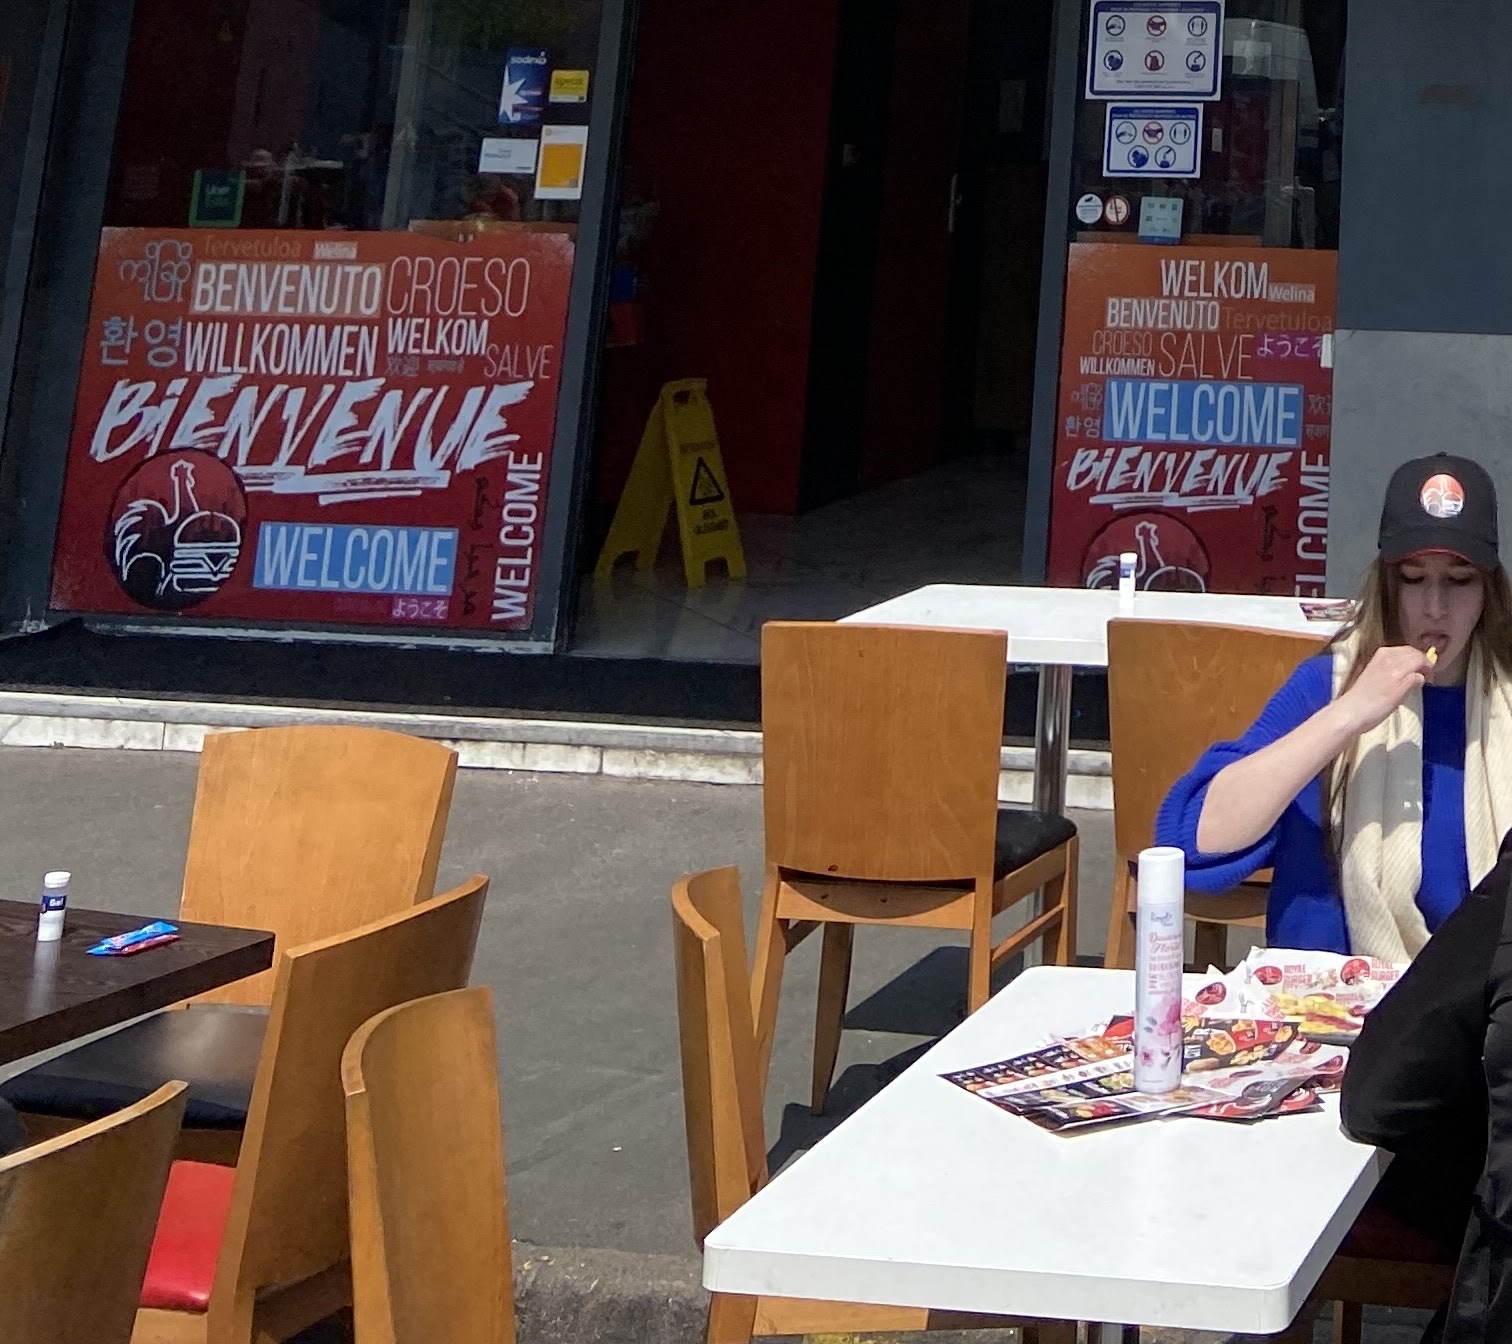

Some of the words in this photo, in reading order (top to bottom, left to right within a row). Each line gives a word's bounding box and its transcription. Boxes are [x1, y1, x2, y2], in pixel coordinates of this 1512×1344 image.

[193, 262, 383, 316] BENVENUTO
[387, 256, 531, 317] CROESO
[1160, 258, 1269, 299] WELKOM
[1269, 285, 1315, 302] Welina
[1107, 298, 1220, 330] BENVENUTO
[1223, 307, 1333, 333] Tervetuloa
[184, 321, 380, 377] WILLKOMMEN
[387, 317, 490, 356] WELKOM
[1092, 330, 1153, 357] CROESO
[1158, 332, 1255, 380] SALVE
[483, 343, 555, 380] SALVE
[1080, 355, 1155, 377] WILLKOMMEN
[1110, 380, 1299, 446] WELCOME
[491, 451, 544, 622] WELCOME
[263, 527, 455, 594] WELCOME
[392, 600, 448, 620] ようこそ
